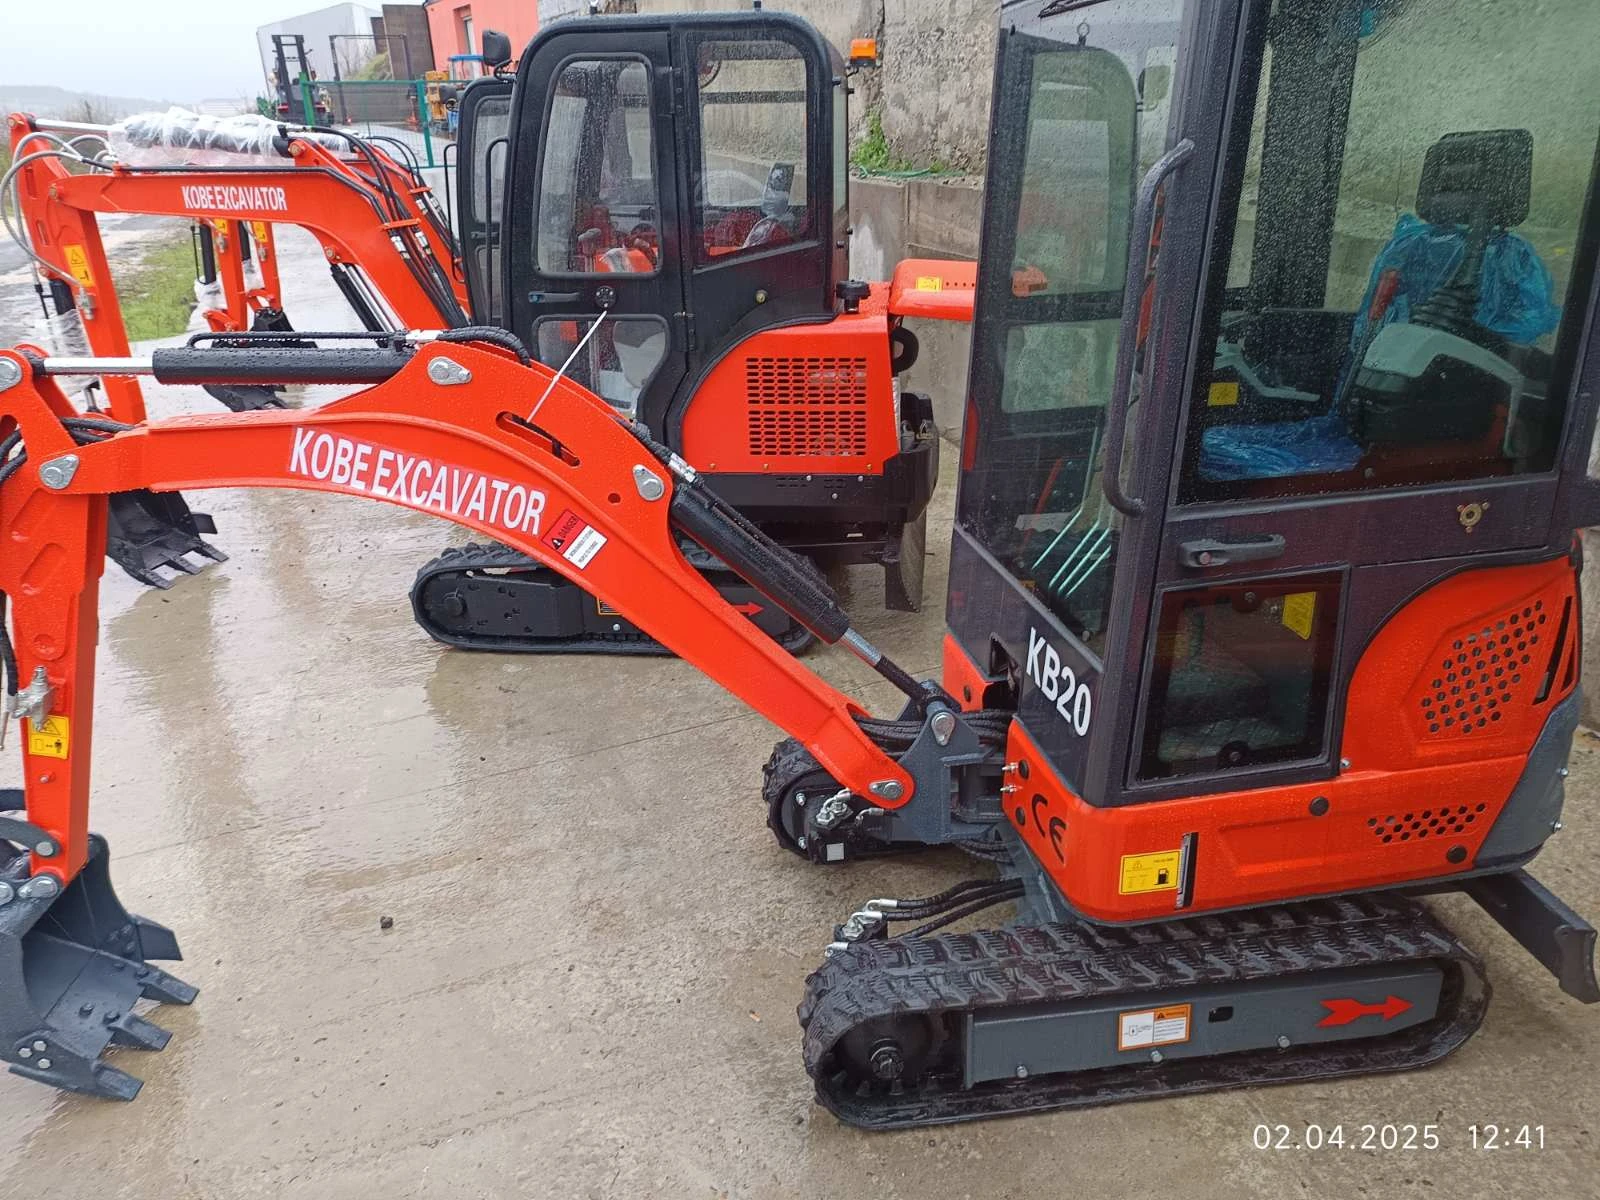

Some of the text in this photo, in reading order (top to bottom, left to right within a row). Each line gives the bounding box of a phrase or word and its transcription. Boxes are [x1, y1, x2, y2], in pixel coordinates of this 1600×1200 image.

[181, 185, 288, 211] KOBE EXCAVATOR
[290, 427, 546, 536] KOBE EXCAVATOR
[1026, 626, 1092, 737] KB20
[1031, 793, 1067, 865] CE
